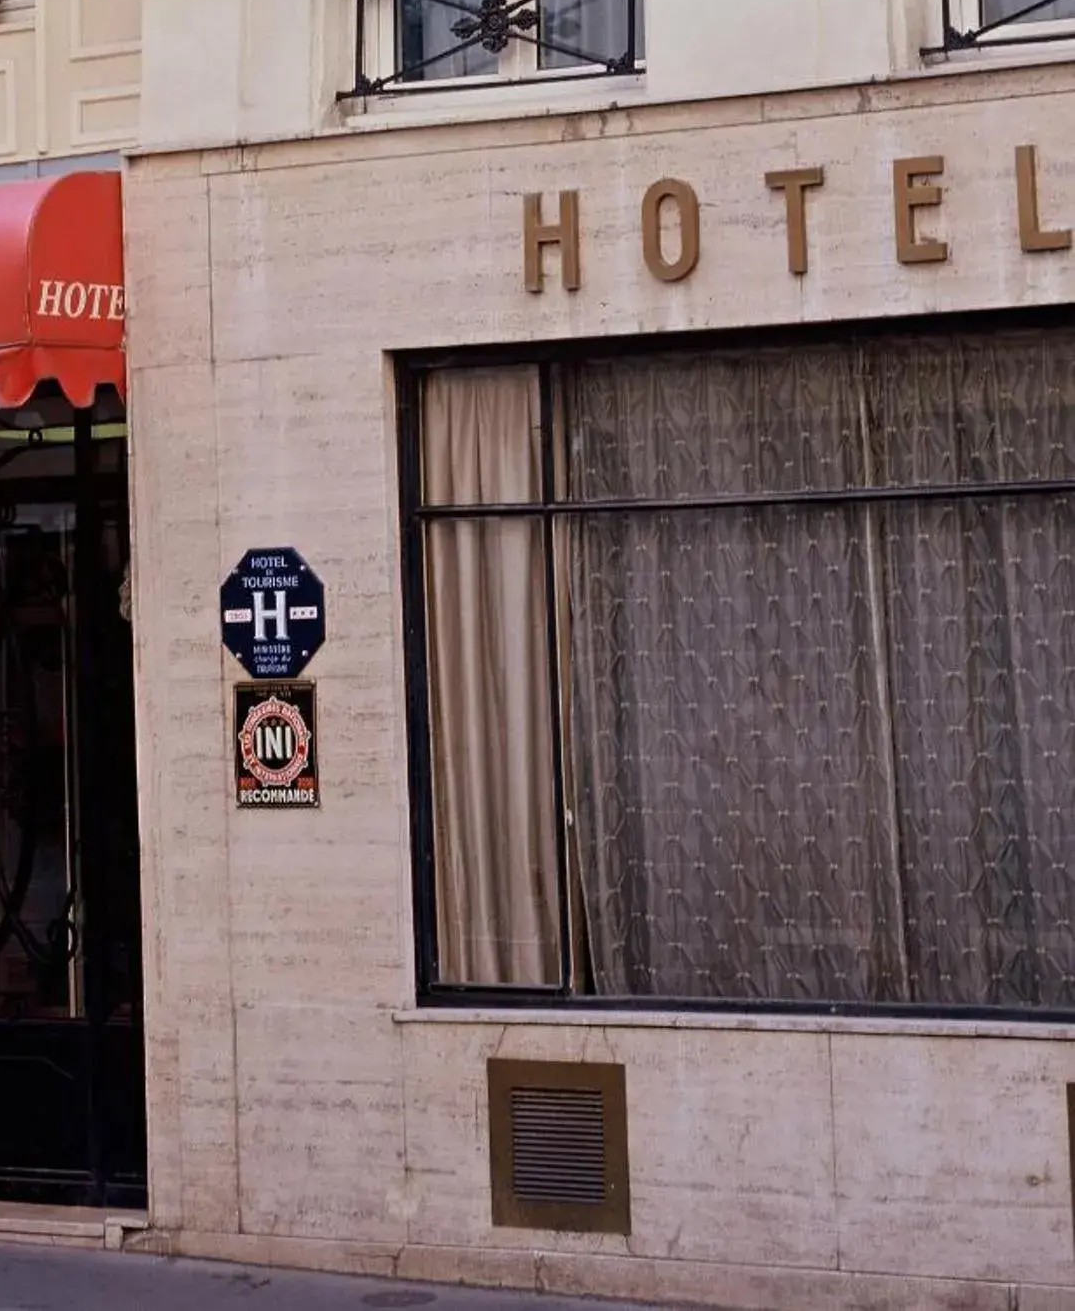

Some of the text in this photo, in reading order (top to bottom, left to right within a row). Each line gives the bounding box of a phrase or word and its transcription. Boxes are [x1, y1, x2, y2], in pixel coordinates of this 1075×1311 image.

[523, 144, 1074, 294] HOTEL
[242, 575, 299, 588] TOURISME
[252, 590, 290, 641] H
[256, 726, 293, 760] INI
